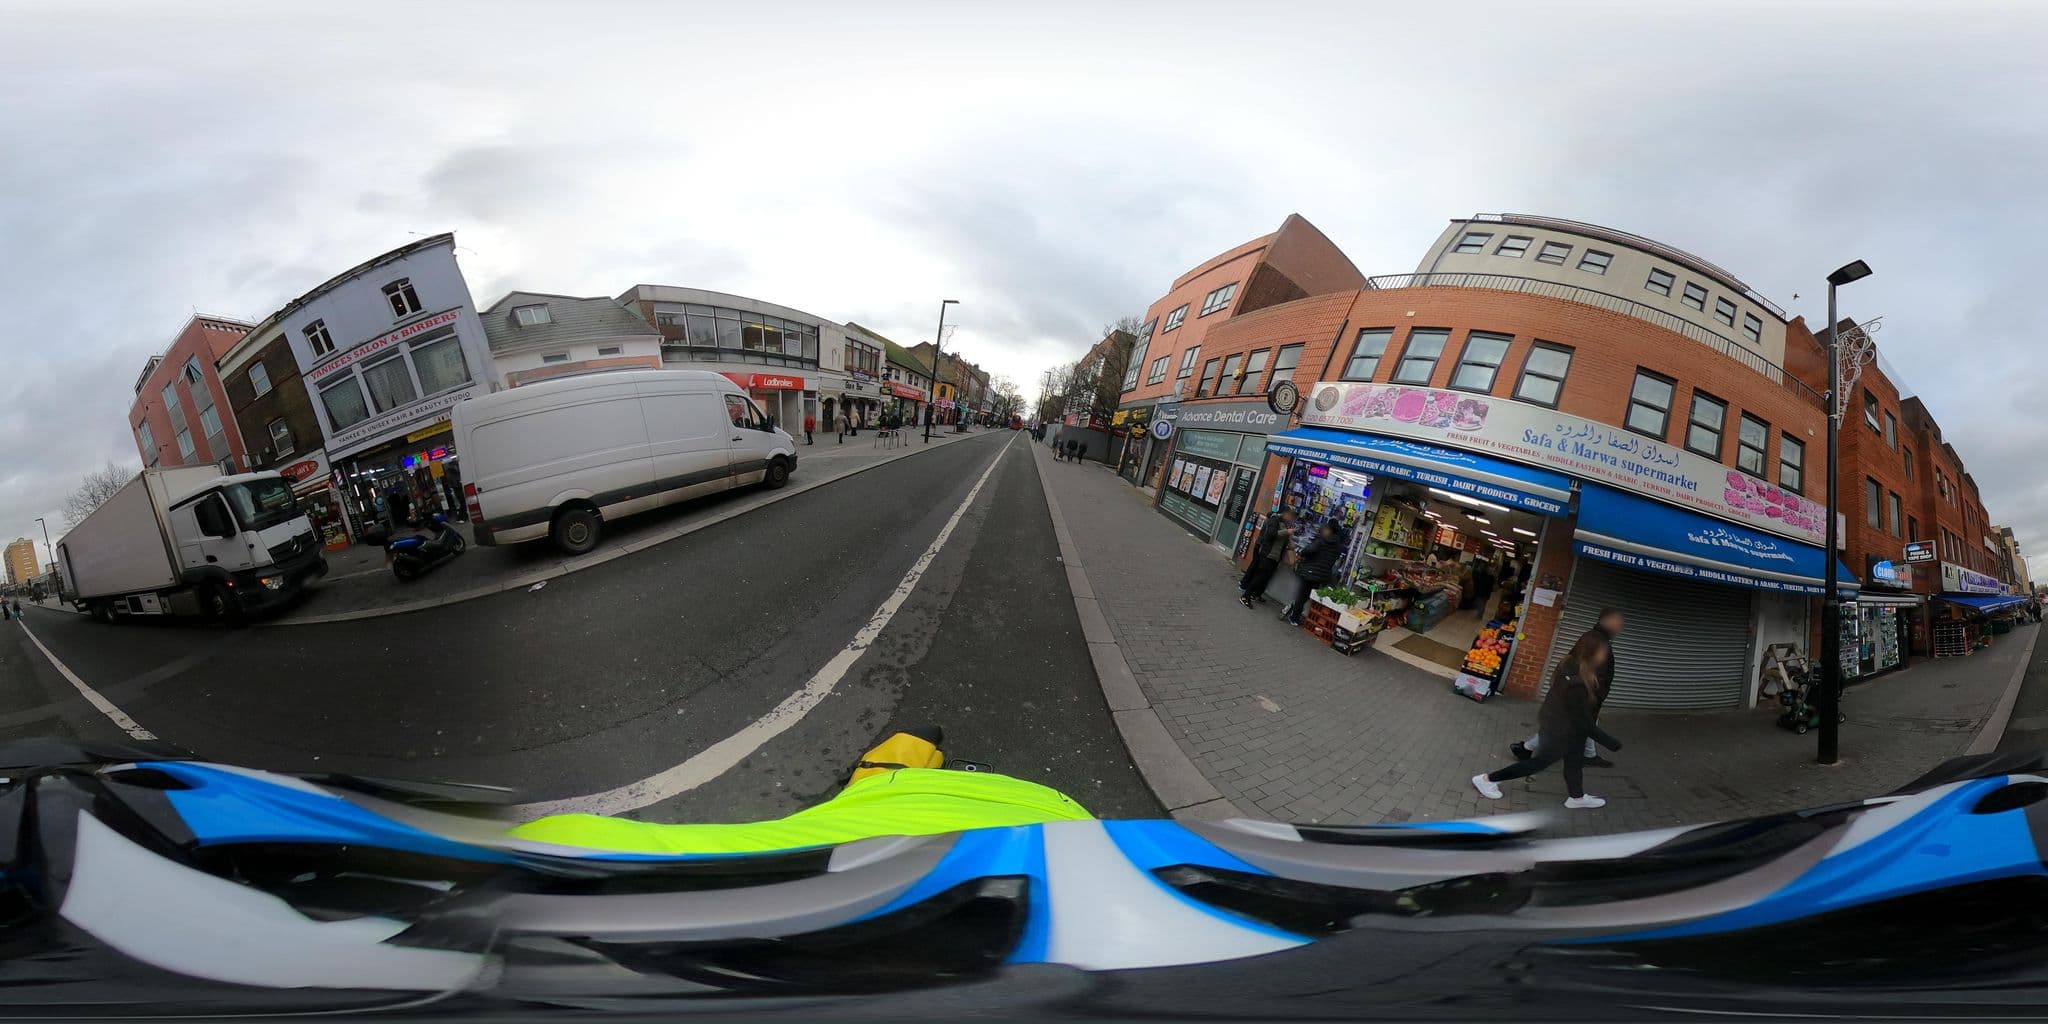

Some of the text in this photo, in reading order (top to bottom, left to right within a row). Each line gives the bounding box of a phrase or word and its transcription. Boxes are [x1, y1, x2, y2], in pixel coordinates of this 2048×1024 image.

[311, 311, 457, 380] YANKEES SALON & BARBERS
[367, 420, 390, 432] UNISEX
[391, 413, 408, 423] HAIR
[415, 400, 443, 415] BEAUTY
[443, 391, 471, 405] STUDIO
[1181, 411, 1212, 422] Advance
[1213, 410, 1246, 423] Dental
[1247, 410, 1278, 425] Care
[1447, 432, 1468, 441] FRESH
[1469, 436, 1490, 446] FRUIT
[1575, 461, 1607, 476] EASTERN
[1523, 428, 1698, 492] Safa & Marwa supermarket
[1352, 457, 1380, 471] EASTERN
[1380, 462, 1386, 471] &
[1477, 485, 1519, 502] PRODUCTS
[1583, 545, 1611, 559] FRESH
[1611, 552, 1637, 566] FRUIT
[1637, 558, 1644, 566] &
[1688, 533, 1710, 545] Safa
